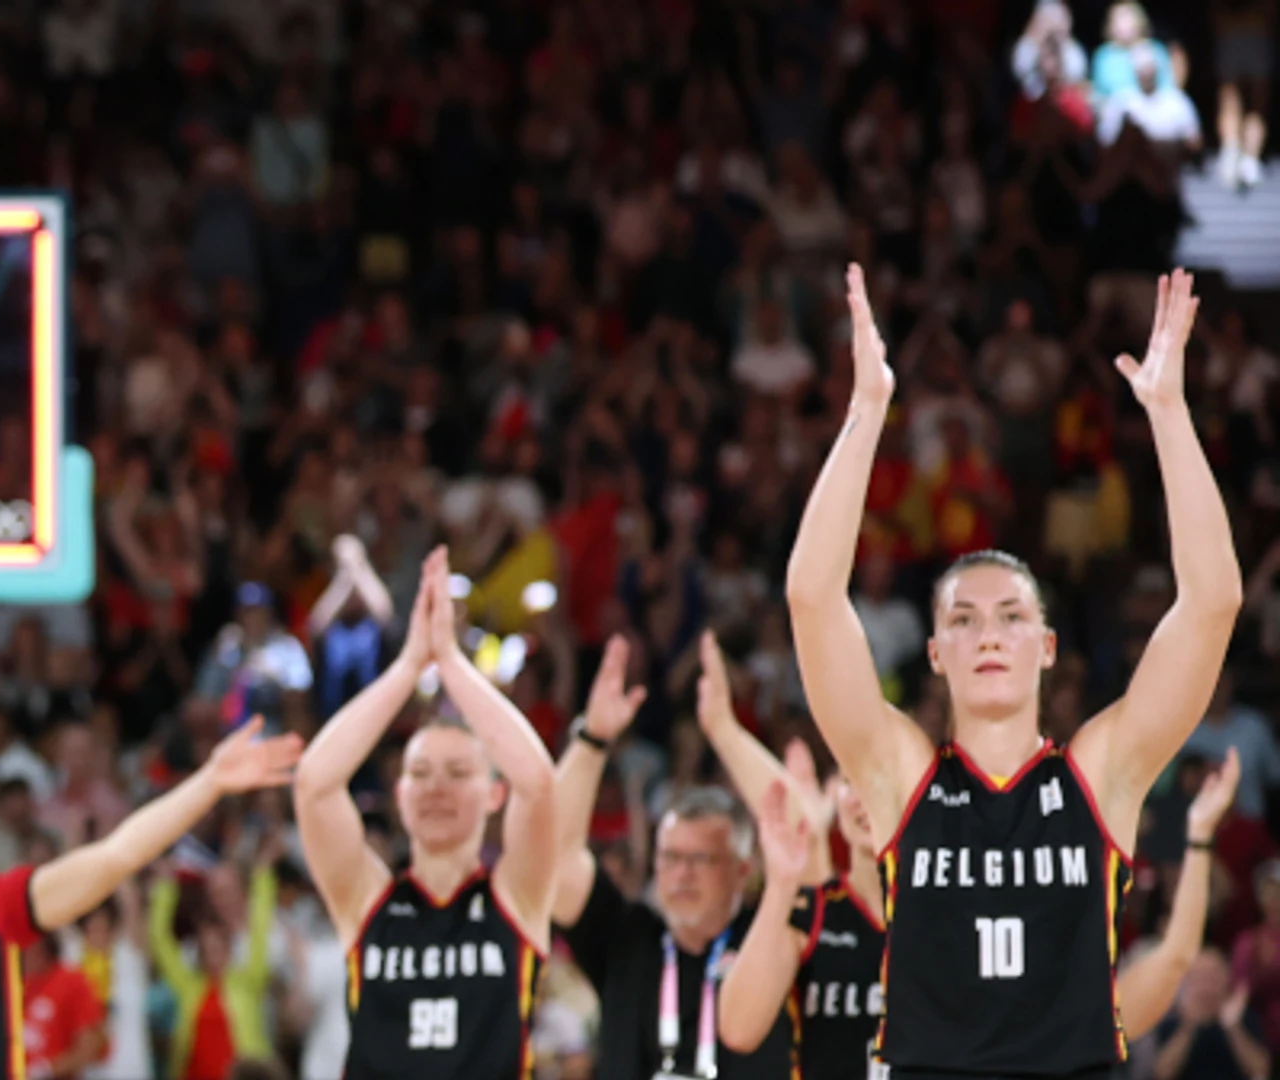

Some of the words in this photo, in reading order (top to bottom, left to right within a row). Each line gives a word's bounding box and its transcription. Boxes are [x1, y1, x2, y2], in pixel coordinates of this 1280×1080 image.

[911, 845, 1089, 888] BELGIUM
[363, 941, 505, 981] BELGIUM
[974, 916, 1025, 979] 10
[408, 997, 459, 1049] 99
